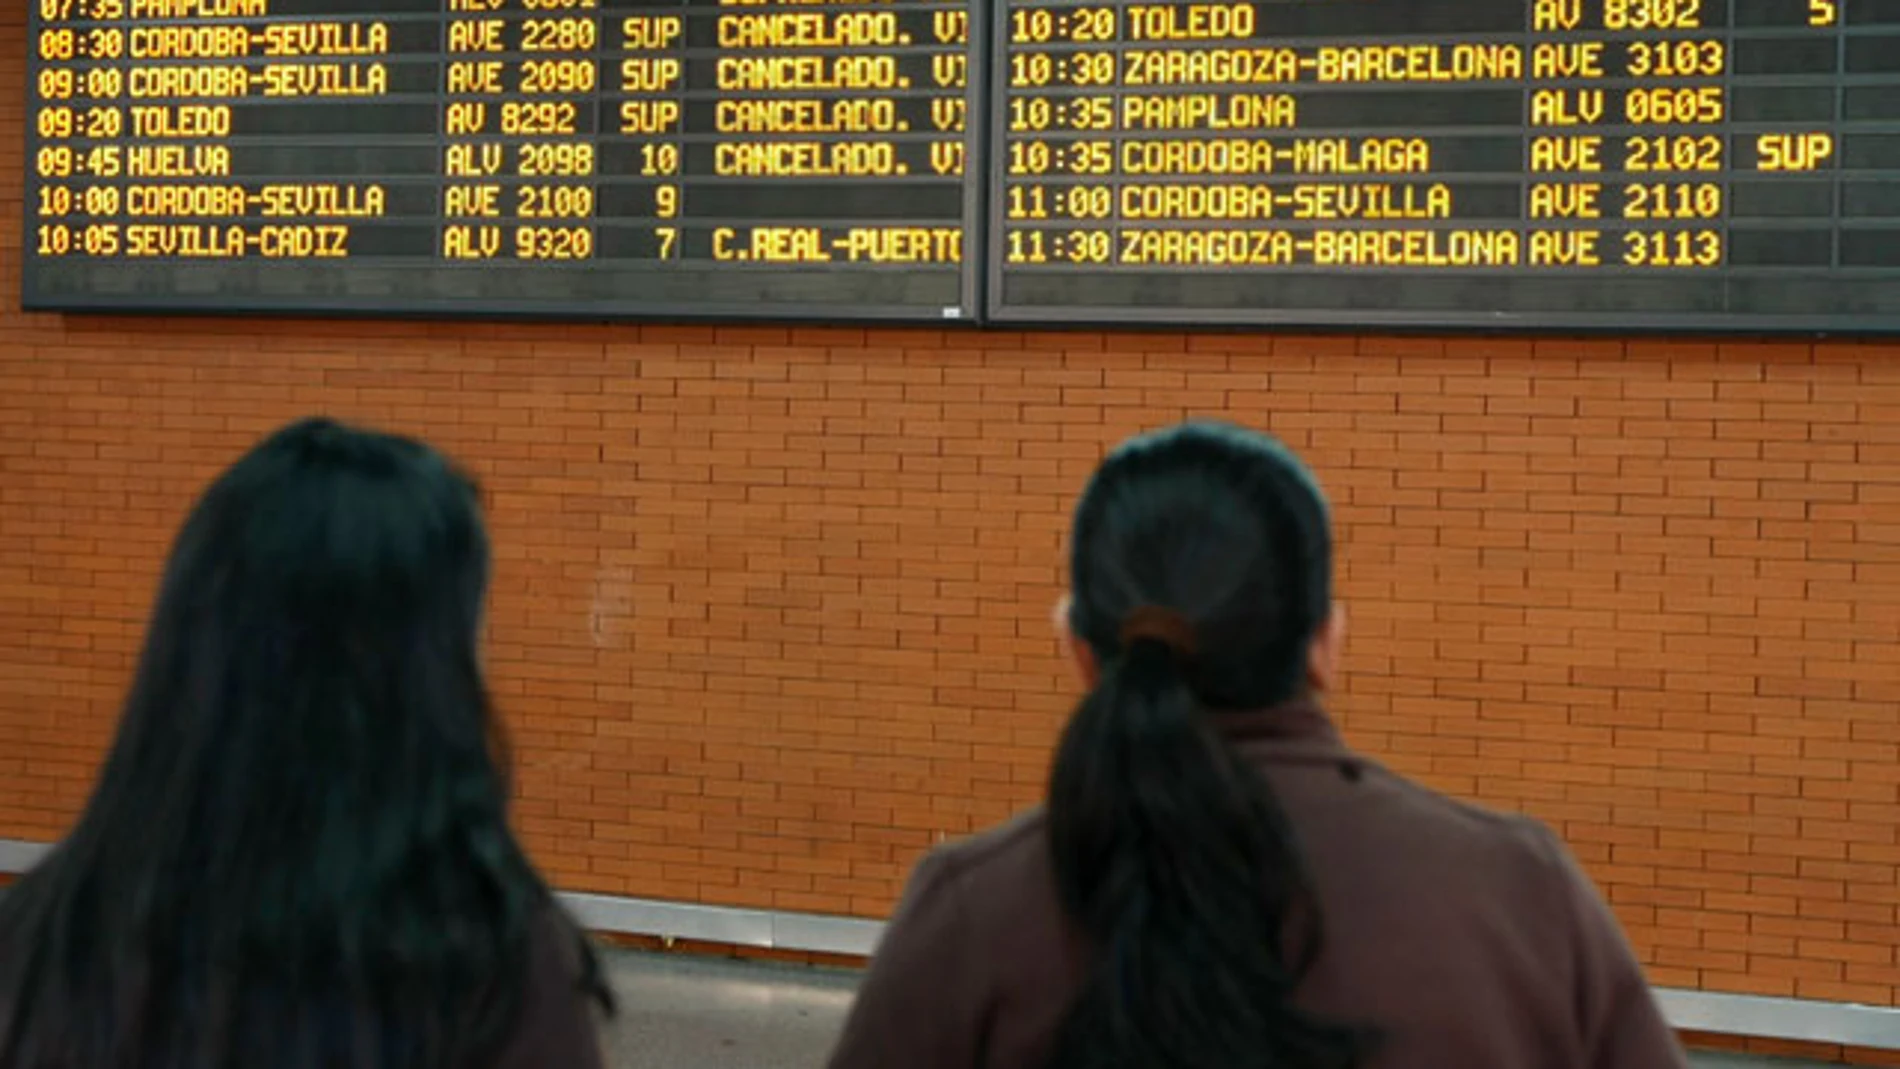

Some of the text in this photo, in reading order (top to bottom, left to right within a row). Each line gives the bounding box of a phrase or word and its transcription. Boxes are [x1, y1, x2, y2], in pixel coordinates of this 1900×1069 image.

[39, 27, 124, 60] 08:30
[129, 22, 388, 58] CORDOBA-SEVILLA
[449, 19, 505, 52] AVE
[521, 17, 596, 51] 2280
[623, 16, 681, 49] SUP
[718, 11, 911, 48] CANCELADO.
[1012, 0, 1834, 43] 10:20 TOLEDO AV 8302 5
[38, 66, 123, 100] 09:00
[128, 61, 387, 98] CORDOBA-SEVILLA
[447, 61, 504, 93] AVE
[519, 59, 596, 93] 2090
[621, 58, 680, 92] SUP
[716, 55, 910, 90] CANCELADO.
[1011, 40, 1723, 87] 10:30 ZARAGOZA-BARCELONA AVE 3103
[37, 106, 123, 138] 09:20
[130, 104, 231, 138] TOLEDO
[446, 102, 485, 135] AV
[500, 101, 576, 135] 8292
[620, 100, 679, 134] SUP
[715, 98, 909, 133] CANCELADO.
[1010, 87, 1723, 132] 10:35 PAMPLONA ALV 0605
[36, 145, 121, 178] 09:45
[126, 144, 230, 177] HUELVA
[446, 142, 502, 177] ALV
[518, 142, 594, 177] 2098
[641, 143, 679, 176] 10
[715, 141, 908, 177] CANCELADO.
[1009, 133, 1832, 175] 10:35 CORDOBA-MALAGA AVE 2102 SUP
[38, 184, 677, 218] 10:00 CORDOBA-SEVILLA AVE 2100 9
[1008, 183, 1720, 220] 11:00 CORDOBA-SEVILLA AVE 2110
[37, 223, 120, 256] 10:05
[126, 224, 348, 257] SEVILLA-CADIZ
[443, 224, 500, 259] ALV
[515, 225, 592, 259] 9320
[655, 227, 676, 260] 7
[1007, 228, 1720, 269] 11:30 ZARAGOZA-BARCELONA AVE 3113
